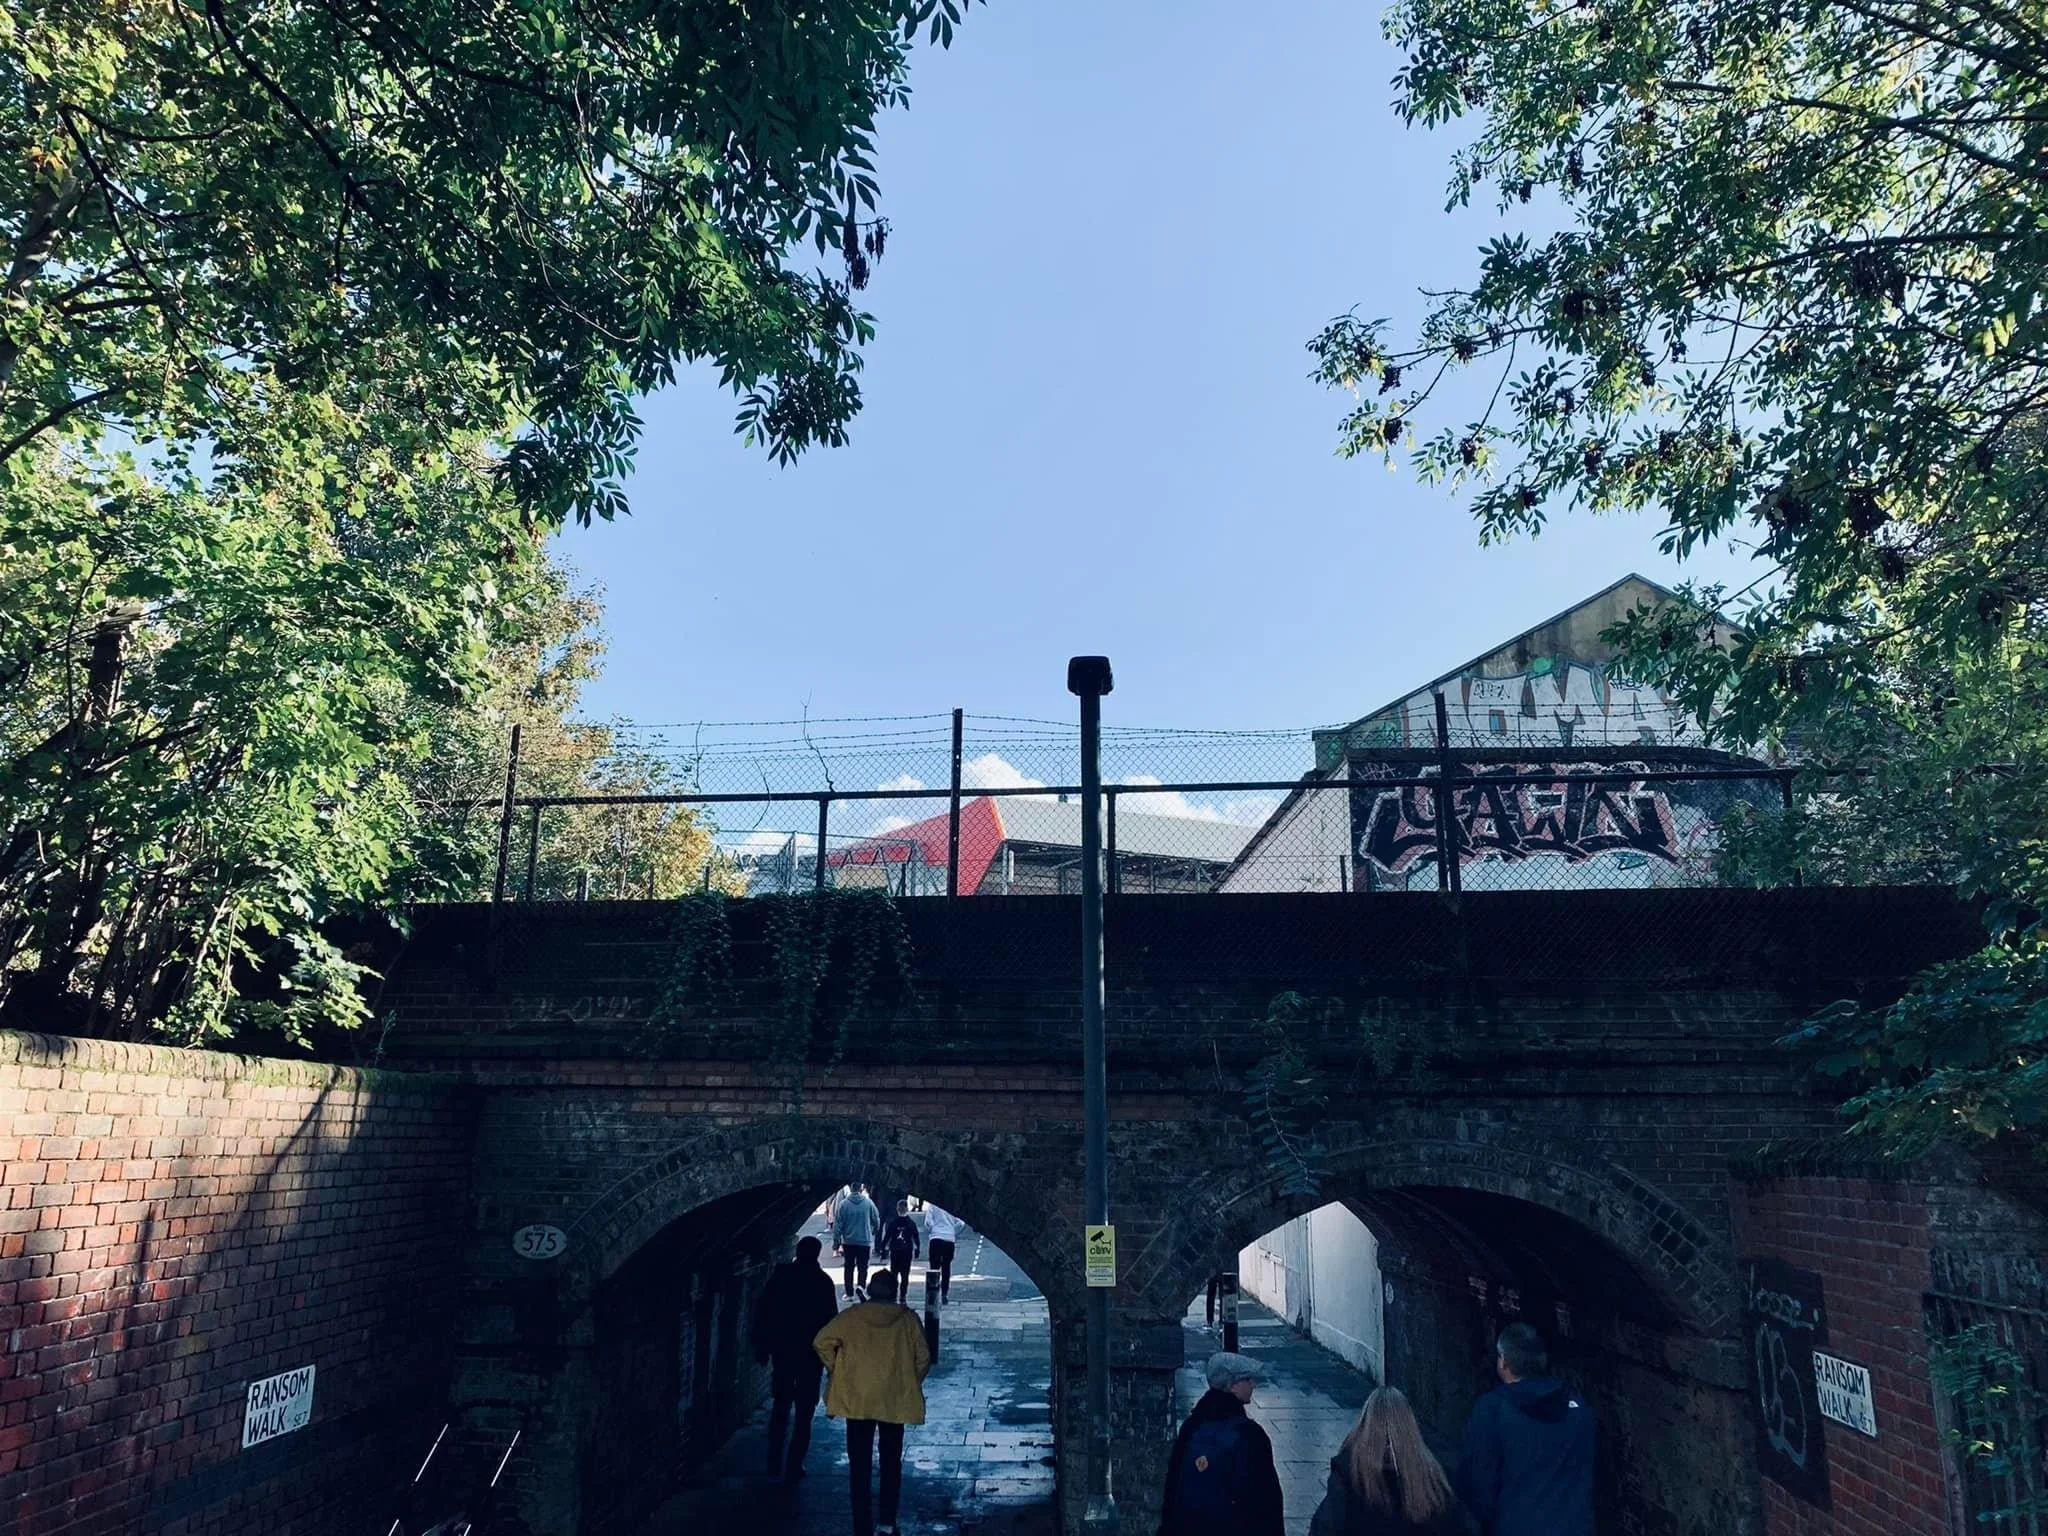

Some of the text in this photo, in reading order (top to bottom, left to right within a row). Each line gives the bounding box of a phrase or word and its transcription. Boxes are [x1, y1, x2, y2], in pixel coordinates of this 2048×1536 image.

[522, 1232, 557, 1251] 575
[250, 1368, 310, 1411] RANSOM
[1815, 1354, 1866, 1397] RANSOM
[1819, 1386, 1854, 1424] WALK
[247, 1406, 288, 1443] WALK
